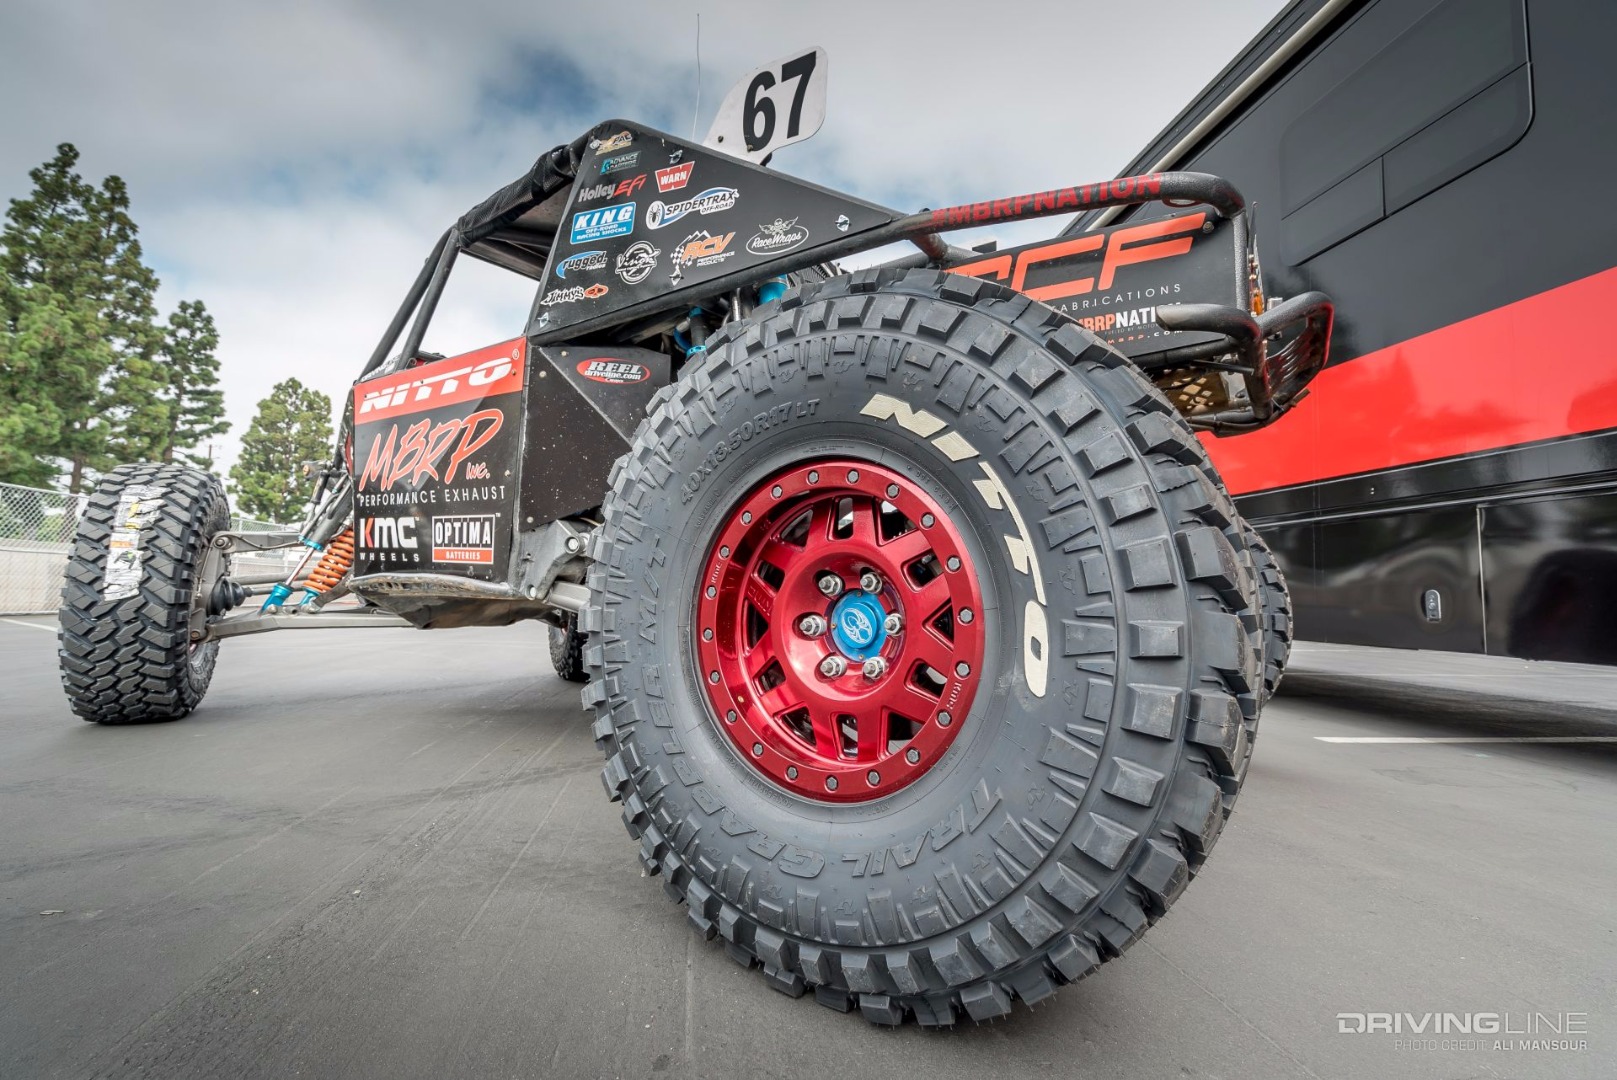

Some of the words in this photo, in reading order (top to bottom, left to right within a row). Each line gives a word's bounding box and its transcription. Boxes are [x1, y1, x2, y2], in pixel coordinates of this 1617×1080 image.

[743, 50, 817, 152] 67
[578, 183, 616, 202] Holley
[614, 174, 647, 196] EFI
[661, 170, 687, 185] WARN
[665, 191, 735, 216] SPIDERTRAX
[701, 201, 734, 214] OFF-ROAD
[575, 205, 633, 229] KING
[602, 227, 627, 236] SHOCKS
[681, 232, 736, 262] RCV
[584, 369, 641, 380] driveline.com
[588, 361, 641, 374] REEL
[358, 357, 513, 414] NITTO
[358, 408, 504, 492] MBRP
[359, 490, 436, 507] PERFORMANCE
[444, 485, 505, 502] EXHAUST
[435, 520, 491, 545] OPTIMA
[360, 552, 420, 562] WHEELS
[445, 550, 481, 560] BATTERIES
[860, 393, 1049, 698] NITTO
[642, 664, 826, 878] GRAPPLER
[841, 777, 1003, 878] TRAIL
